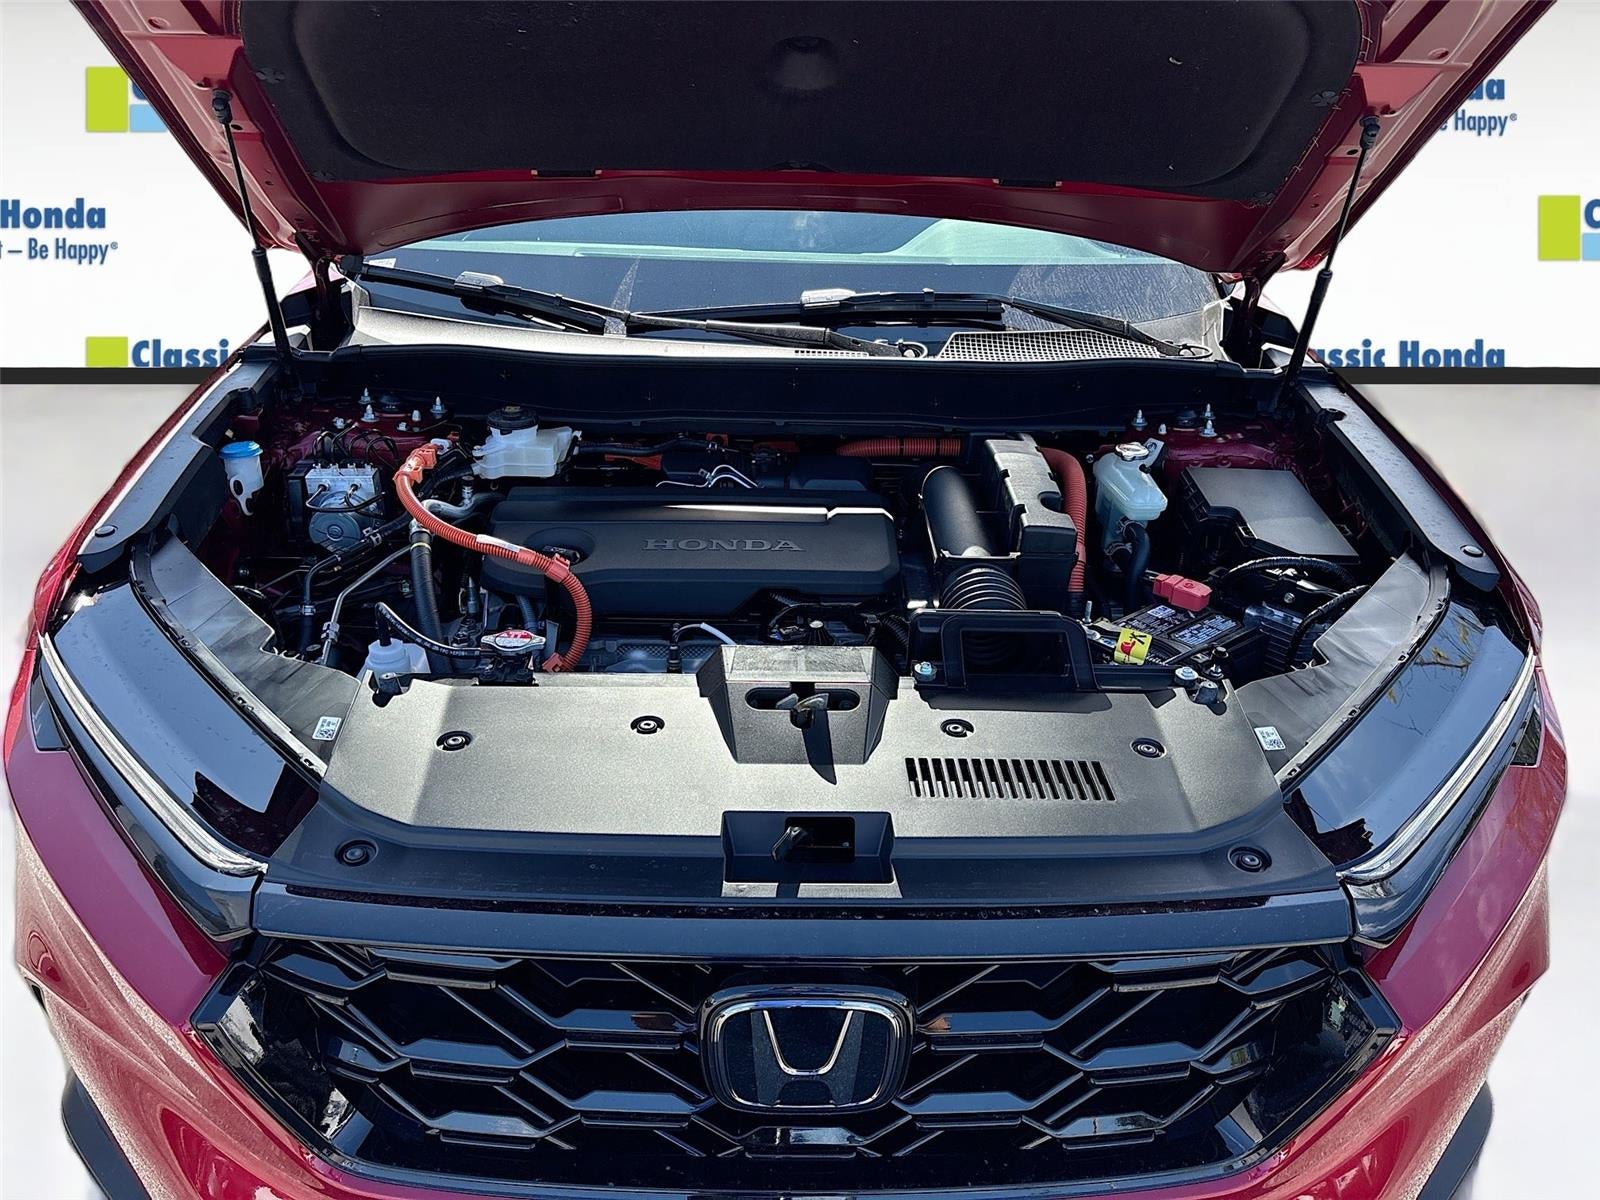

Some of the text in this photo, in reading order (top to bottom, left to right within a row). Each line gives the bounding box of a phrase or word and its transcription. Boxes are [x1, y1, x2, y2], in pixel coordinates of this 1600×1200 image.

[0, 197, 106, 229] Honda
[28, 237, 49, 260] Be
[1399, 338, 1505, 367] Honda
[642, 538, 806, 553] HONDA
